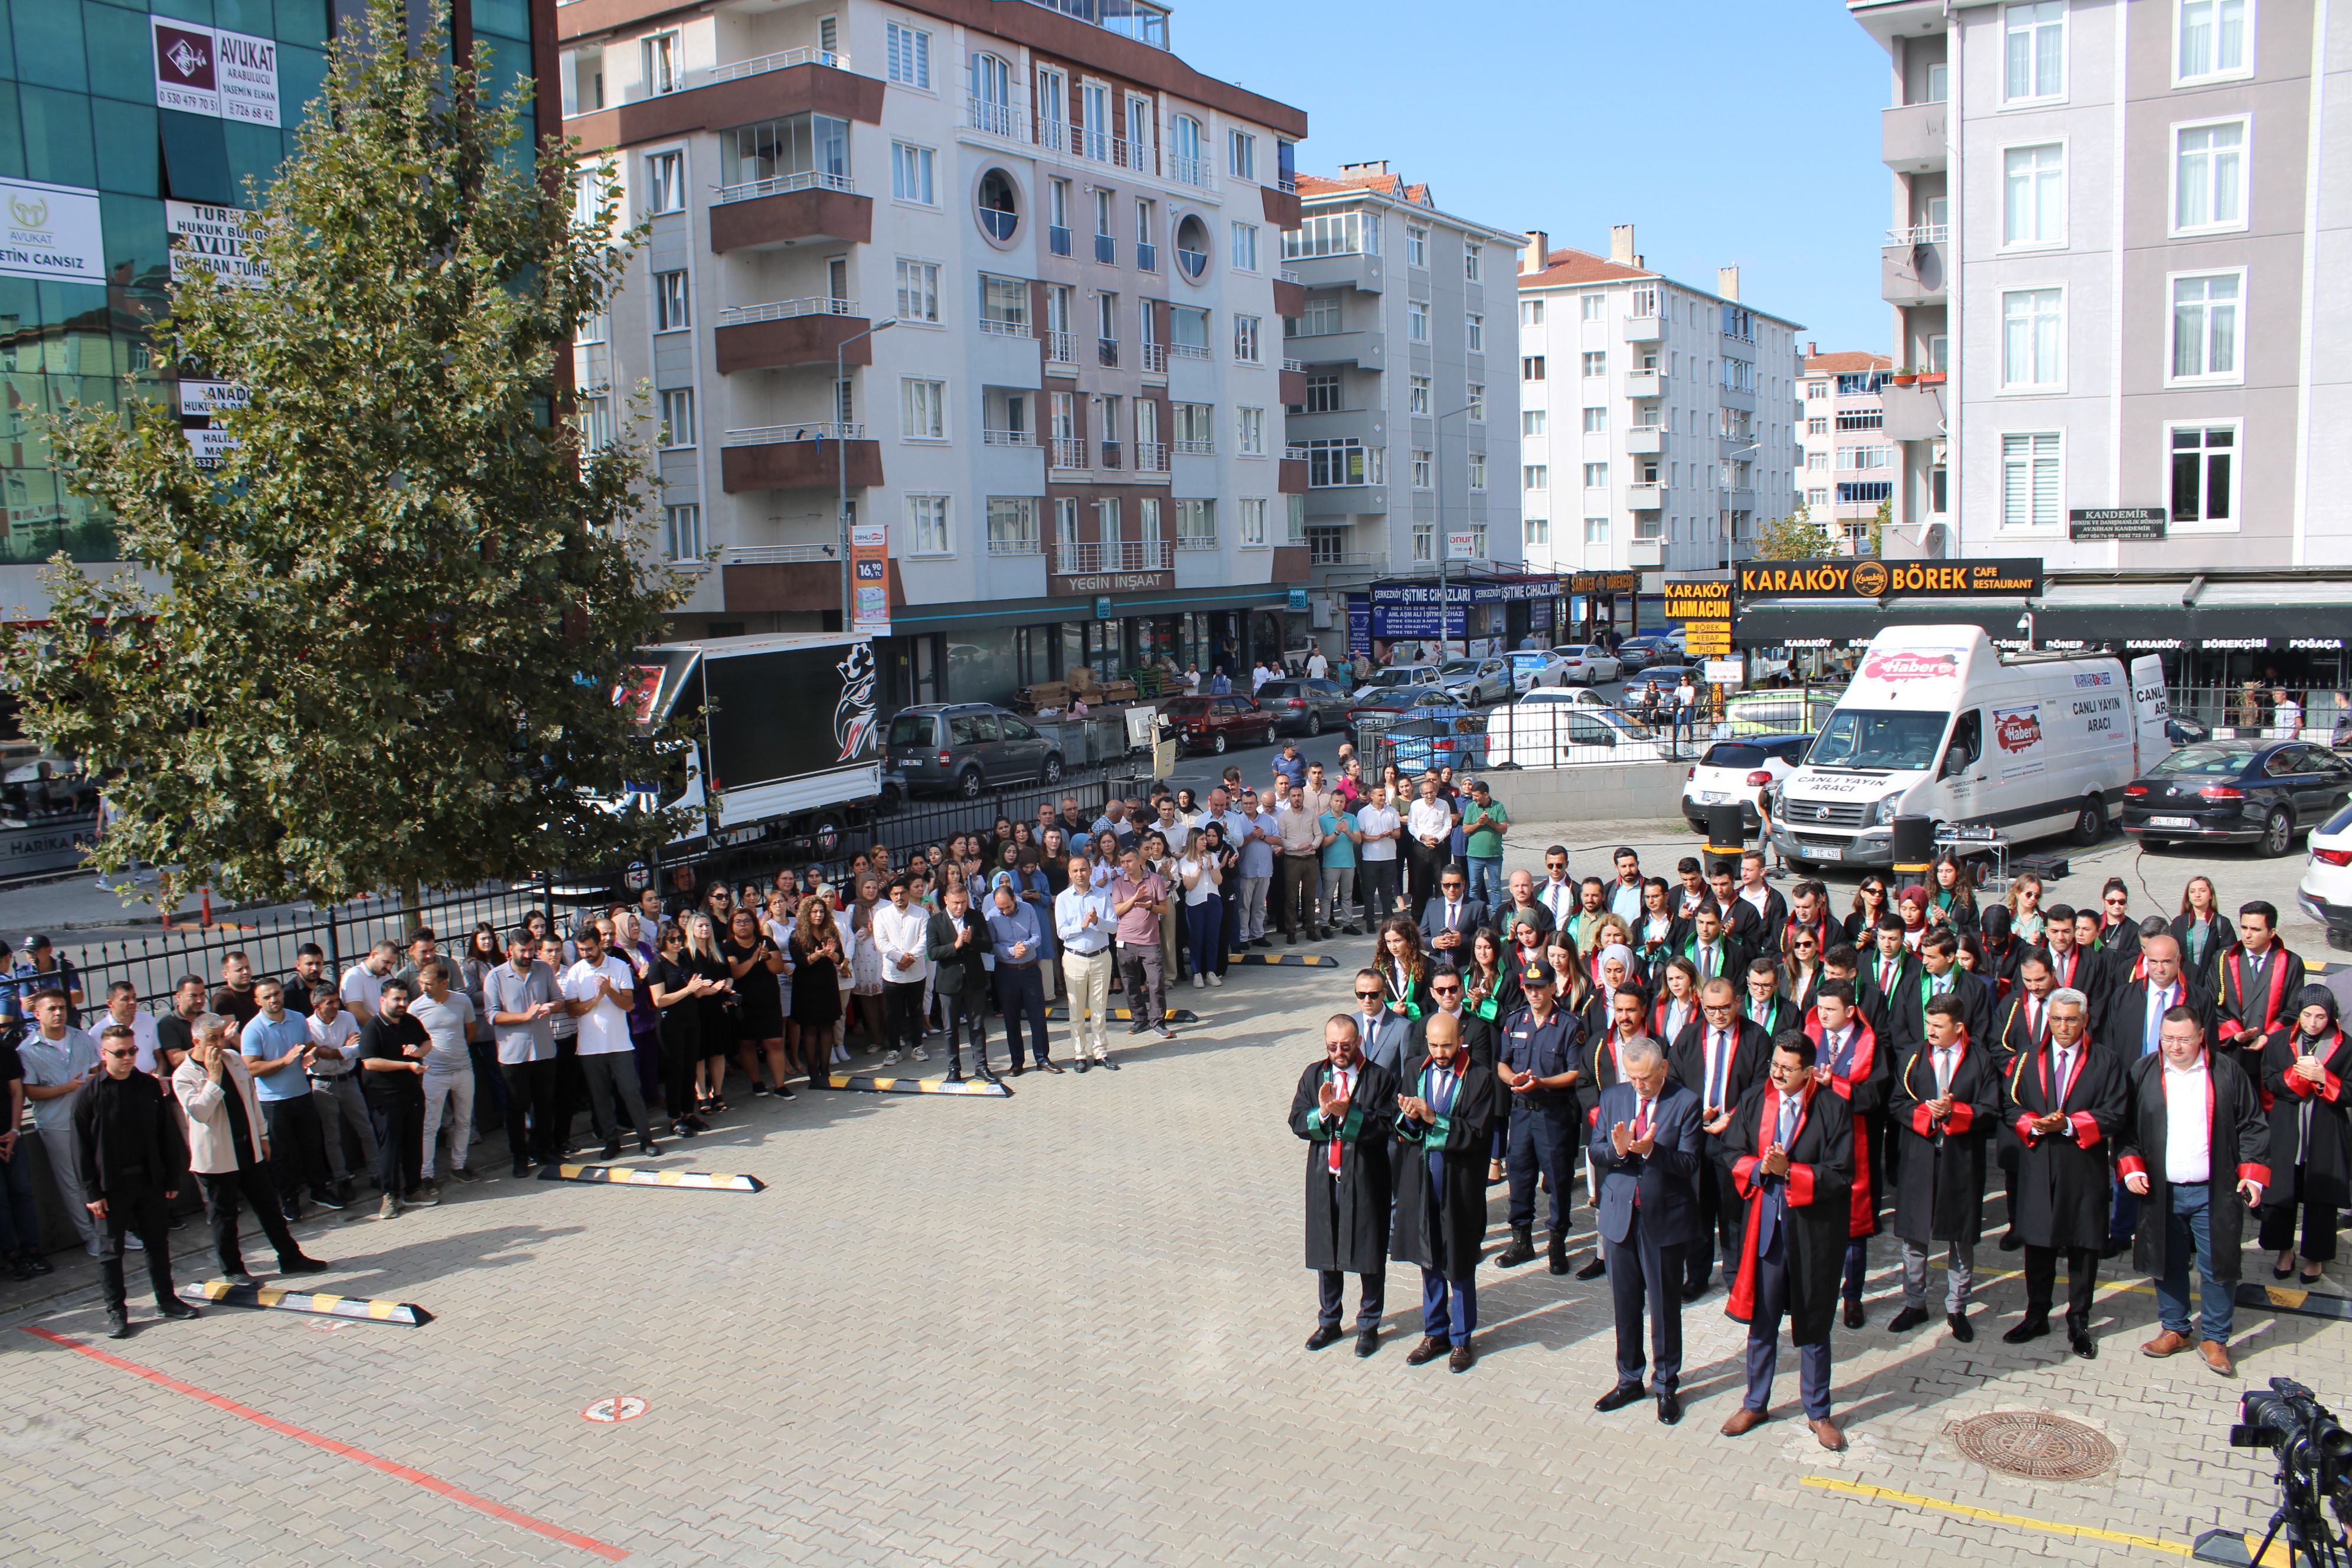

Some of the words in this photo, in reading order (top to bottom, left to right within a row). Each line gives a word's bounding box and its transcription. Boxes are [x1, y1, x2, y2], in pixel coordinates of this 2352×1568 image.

[221, 37, 274, 72] AVUKAT
[228, 68, 270, 85] ARABULUCU
[223, 83, 252, 98] YASEMİN
[254, 90, 275, 102] ELHAN
[160, 91, 165, 102] 0
[168, 92, 181, 104] 530
[184, 95, 197, 107] 479
[200, 98, 208, 109] 70
[211, 100, 218, 112] 51
[236, 104, 249, 117] 726
[253, 107, 262, 119] 68
[264, 110, 274, 121] 42
[177, 220, 223, 236] HUKUK
[9, 231, 53, 244] AVUKAT
[34, 253, 85, 269] CANSIZ
[2085, 509, 2148, 519] KANDEMİR
[1743, 564, 1850, 590] KARAKÖY
[1893, 563, 1968, 590] BÖREK
[1973, 567, 1998, 577] CAFE
[1069, 575, 1109, 590] YEGİN
[1115, 574, 1162, 590] İNŞAAT
[1572, 577, 1595, 592] SARIYER
[1665, 582, 1730, 597] KARAKÖY
[1973, 579, 2033, 589] RESTAURANT
[1374, 589, 1401, 600] ÇERKEZKÖY
[1475, 586, 1501, 600] ÇERKEZKÖY
[1665, 600, 1730, 617] LAHMACUN
[1784, 638, 1832, 647] KARAKÖY
[2046, 639, 2085, 649] DÖNER
[2126, 639, 2182, 649] KARAKÖY
[2202, 638, 2268, 649] BÖREKÇİSİ
[2289, 638, 2341, 649] POĞAÇA
[1886, 661, 1939, 672] Haber
[2137, 685, 2165, 703] CANLI
[2073, 703, 2096, 715] CANLI
[2098, 697, 2120, 711] YAYIN
[2155, 701, 2167, 715] AR
[2088, 717, 2111, 732] ARACI
[2008, 726, 2032, 741] Haber
[11, 837, 70, 855] HARİKA
[2311, 1468, 2319, 1505] Panasonic
